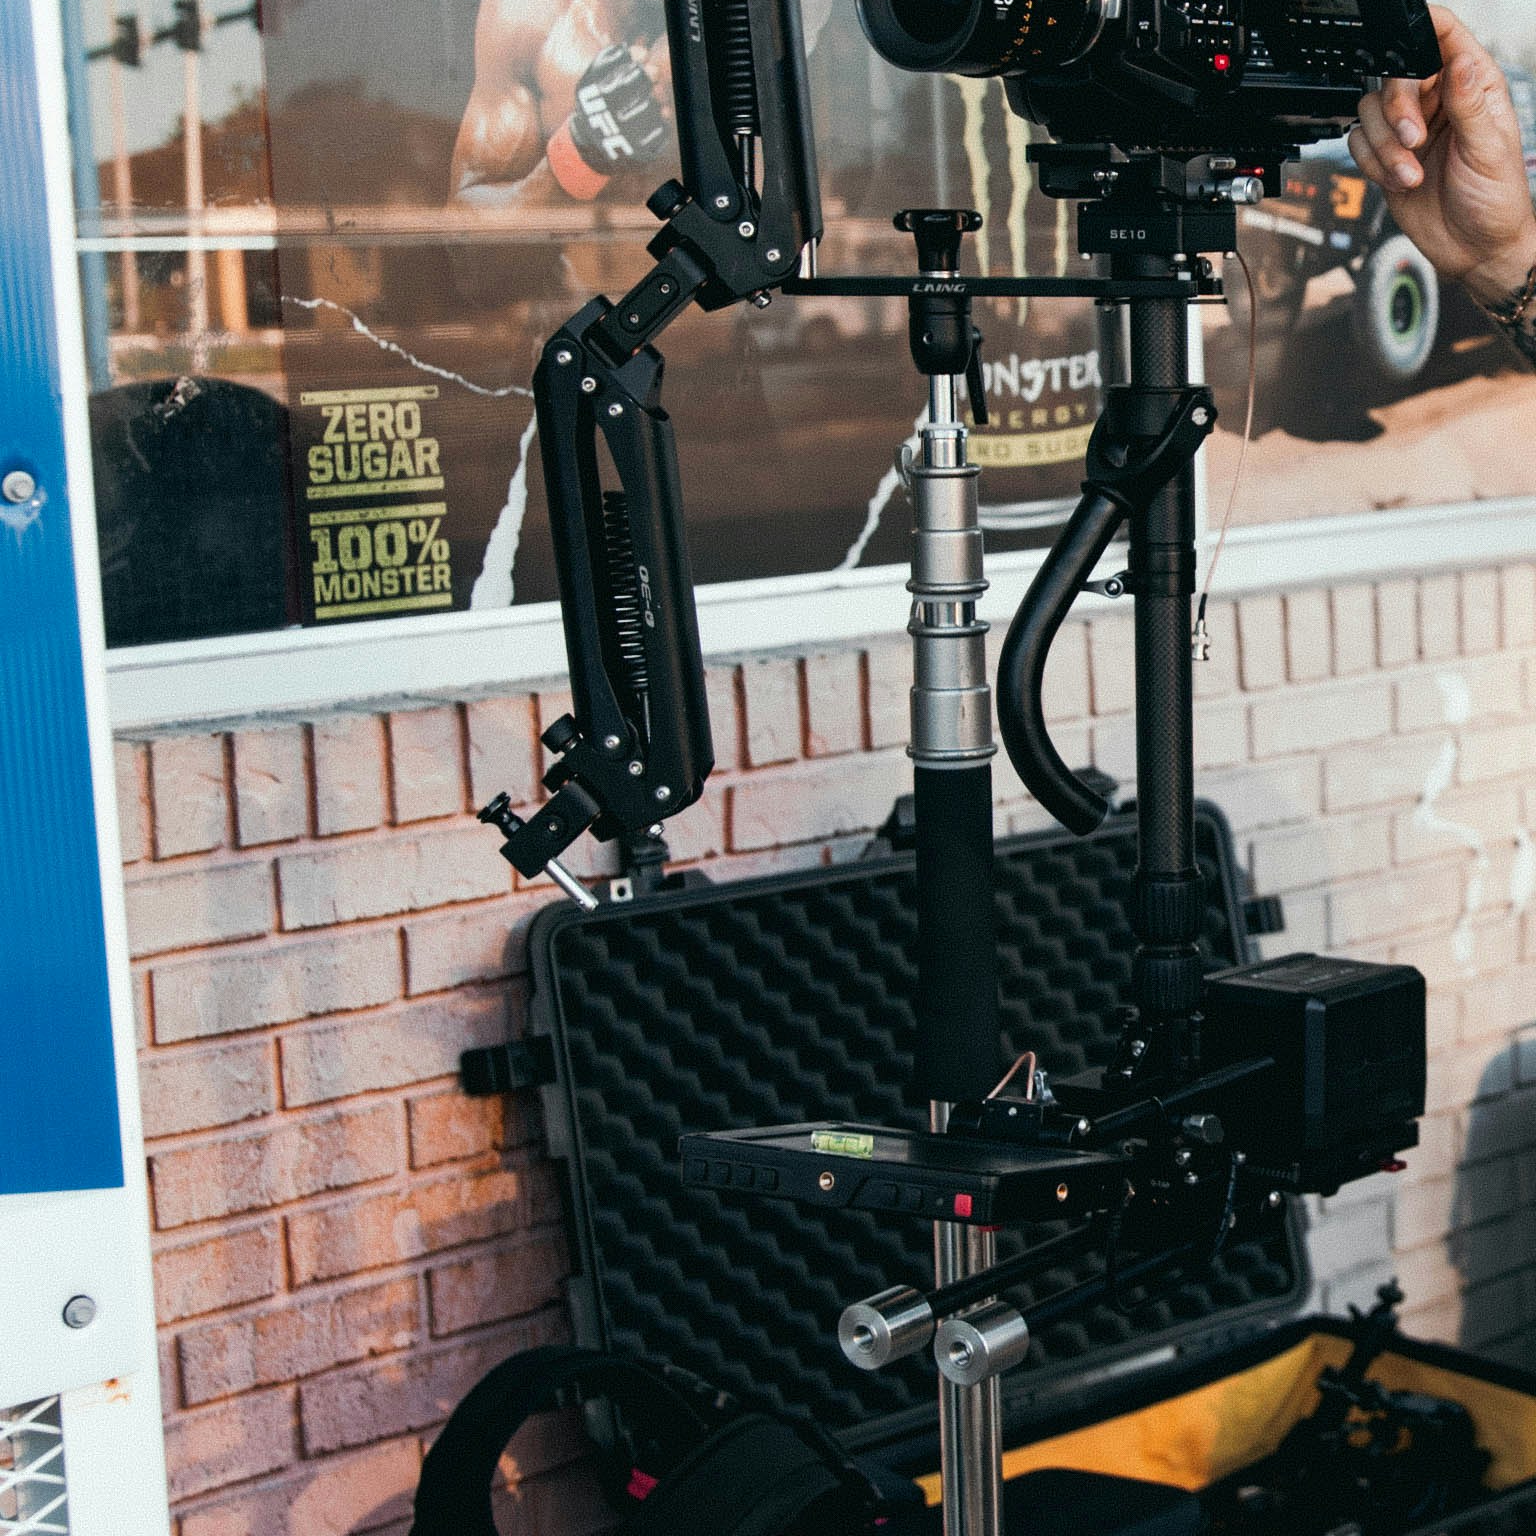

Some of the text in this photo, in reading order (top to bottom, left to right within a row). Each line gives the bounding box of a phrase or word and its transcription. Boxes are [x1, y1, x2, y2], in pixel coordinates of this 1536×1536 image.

[576, 83, 633, 161] UFC
[1109, 228, 1147, 241] SE10
[956, 349, 1102, 403] ONSTER
[321, 400, 422, 444] ZERO
[306, 436, 440, 483] SUGAR
[309, 516, 451, 574] 100%
[312, 562, 452, 605] MONSTER
